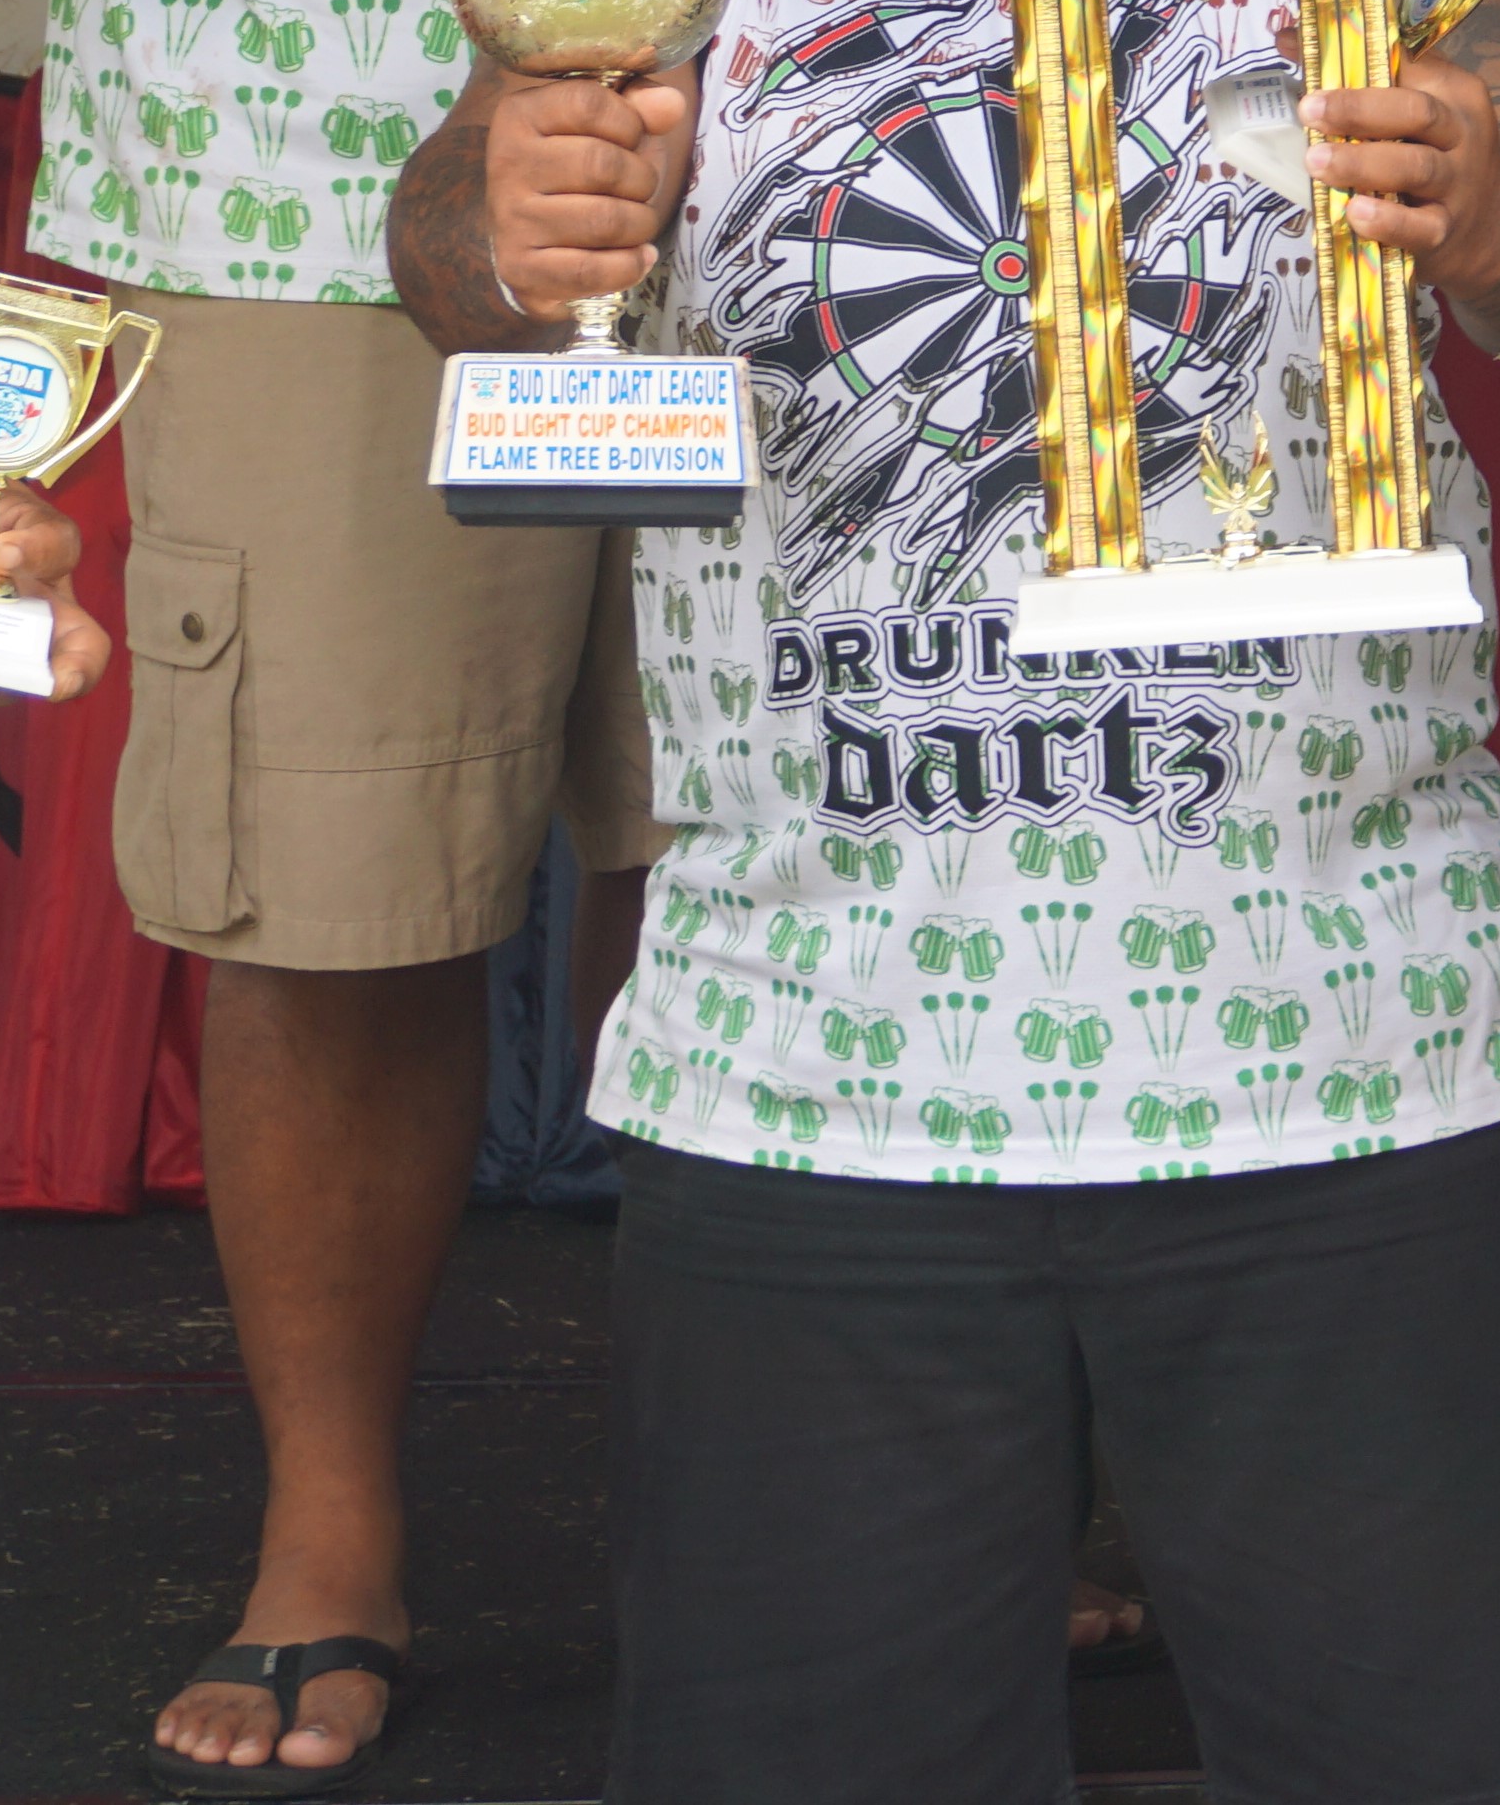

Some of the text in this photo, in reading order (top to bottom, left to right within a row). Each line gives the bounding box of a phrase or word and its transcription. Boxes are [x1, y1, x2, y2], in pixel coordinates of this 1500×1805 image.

[509, 369, 728, 405] BUD LIGHT DART LEAGUE
[467, 413, 727, 438] BUD LIGHT CUP CHAMPION
[467, 446, 725, 471] FLAME TREE B-DIVISION
